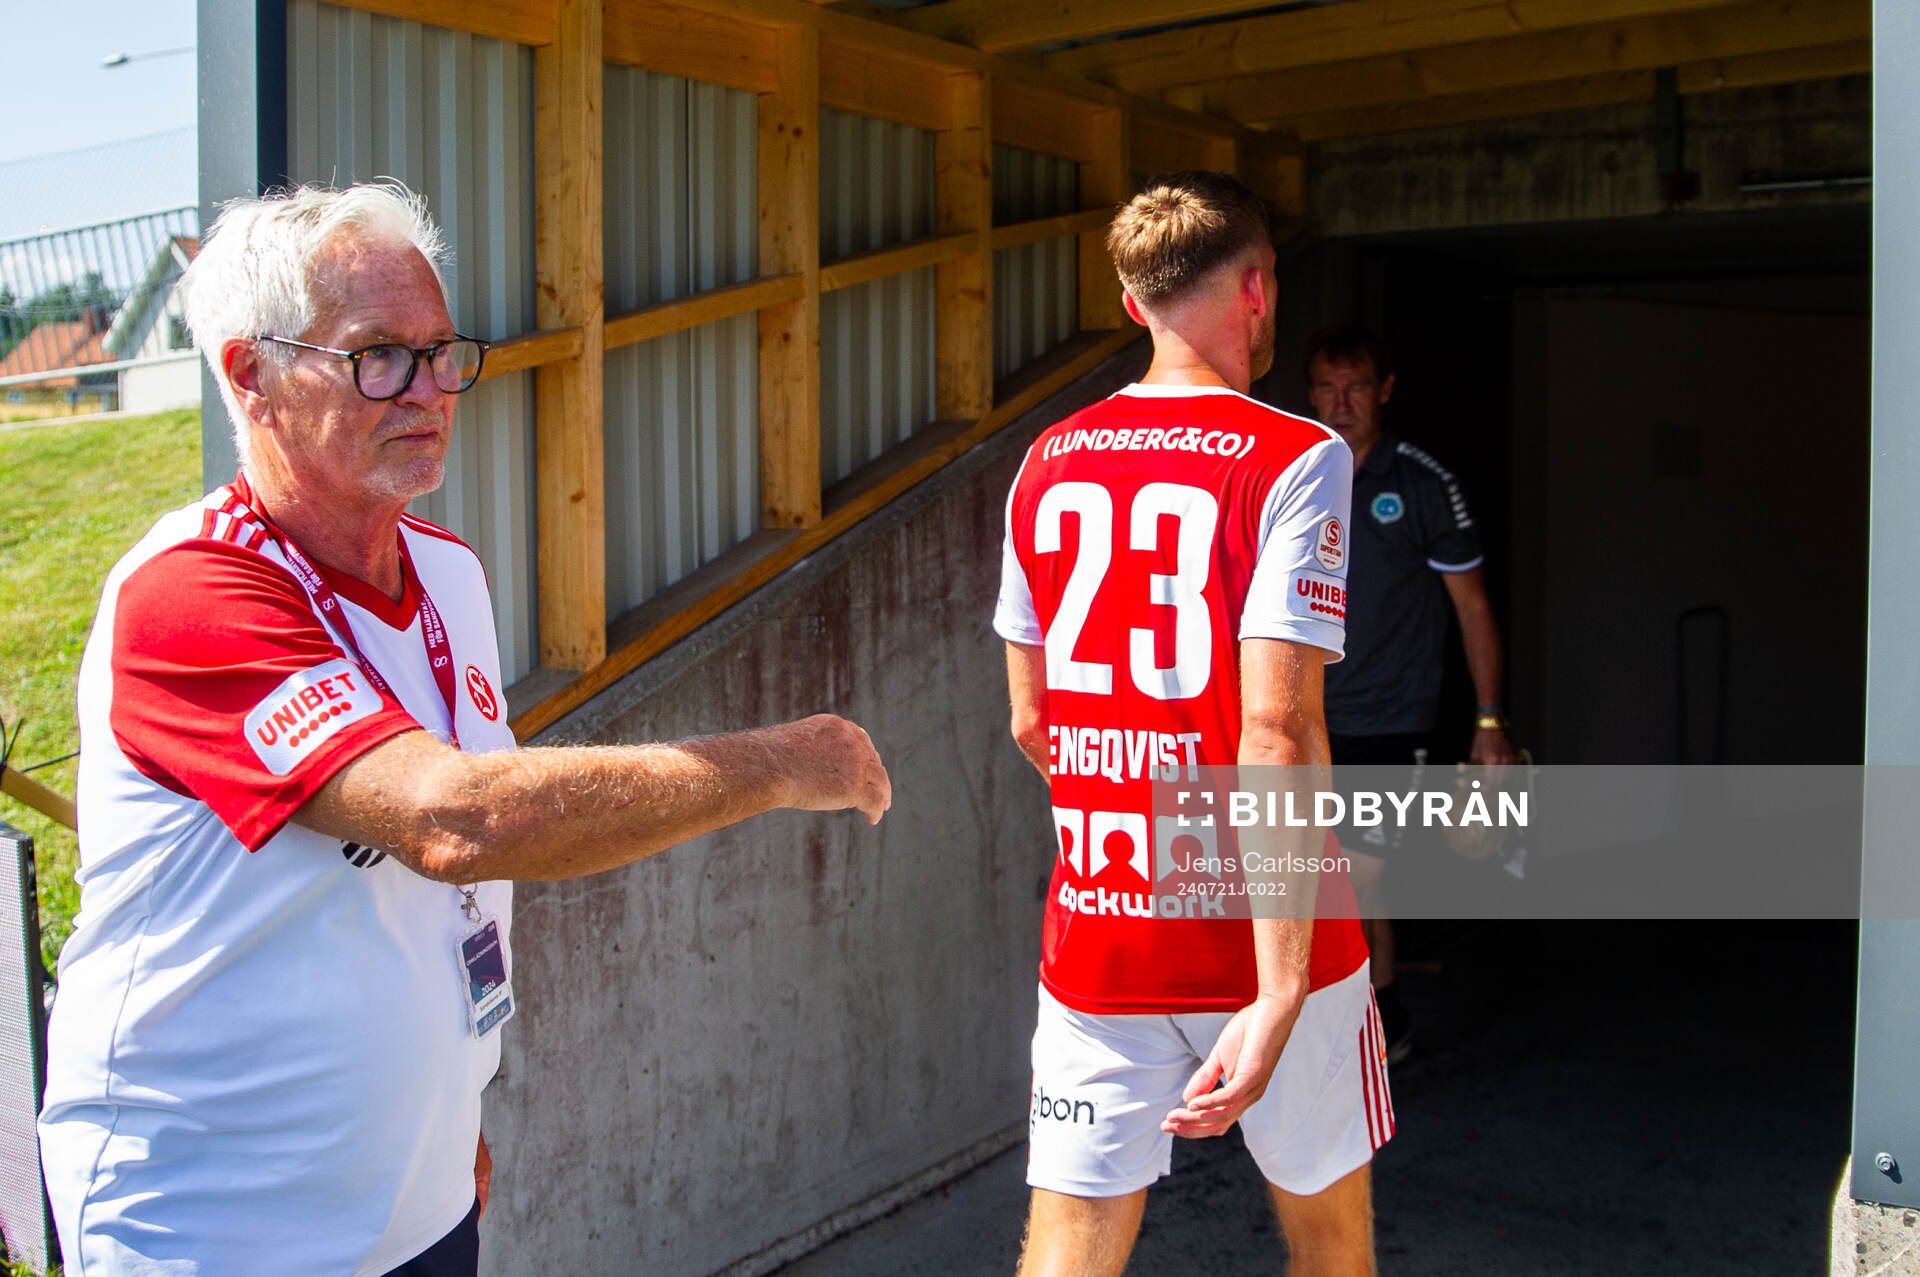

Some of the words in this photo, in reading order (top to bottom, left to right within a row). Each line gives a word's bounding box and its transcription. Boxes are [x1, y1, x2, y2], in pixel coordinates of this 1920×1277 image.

[1043, 426, 1255, 461] (LUNDBERG&CO)
[1034, 481, 1218, 700] 23
[256, 672, 356, 747] UNIBET
[1049, 725, 1202, 783] ENGQVIST
[481, 980, 496, 996] 2024
